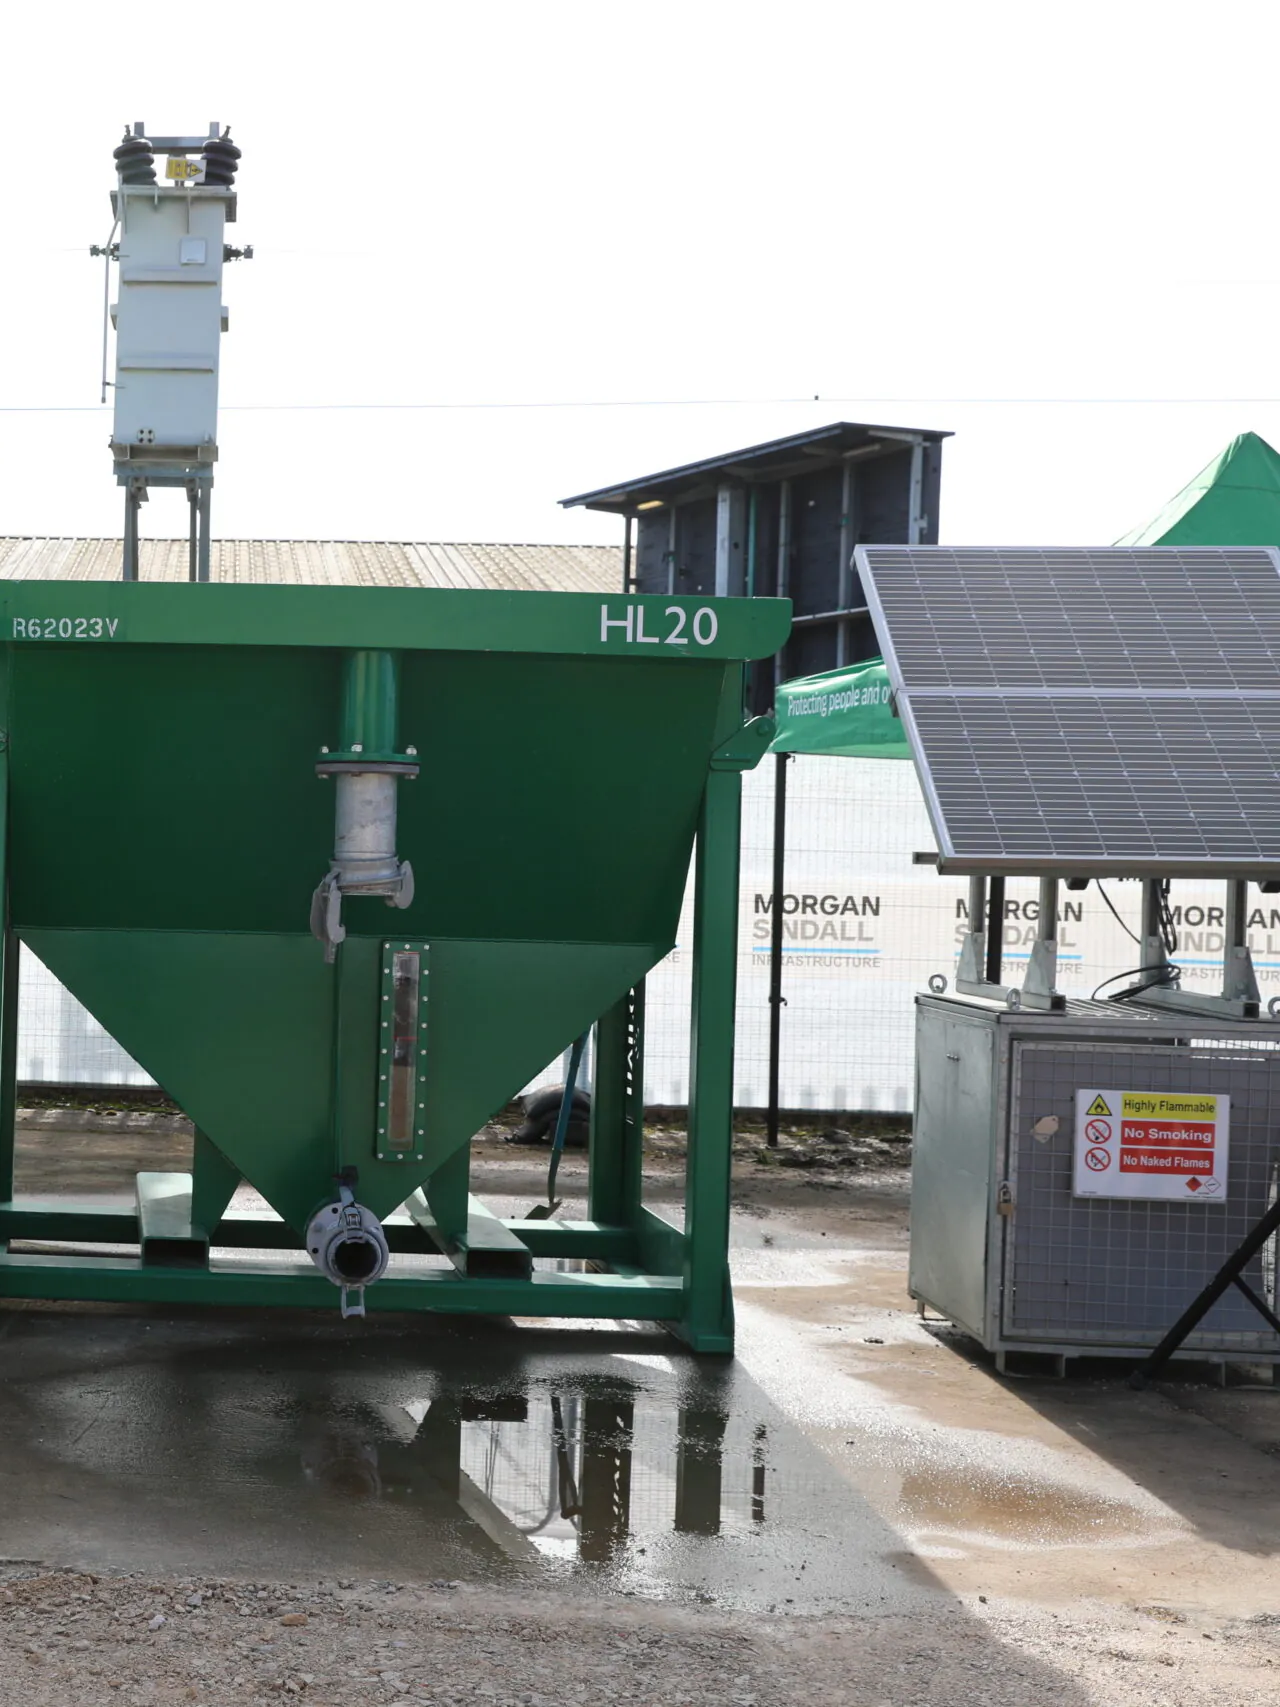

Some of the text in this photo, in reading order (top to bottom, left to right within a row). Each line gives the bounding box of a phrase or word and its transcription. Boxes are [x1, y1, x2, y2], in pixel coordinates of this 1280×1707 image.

[12, 618, 119, 639] R62023V
[599, 604, 719, 646] HL20
[787, 690, 827, 717] Protecting
[828, 684, 860, 714] people
[860, 680, 880, 706] and
[753, 893, 880, 917] MORGAN
[956, 898, 1083, 922] MRGN
[752, 918, 875, 942] SNDALL
[954, 923, 1077, 948] SDAL
[1123, 1099, 1216, 1114] Highly Flammable
[1124, 1127, 1212, 1144] No Smoking
[1123, 1154, 1210, 1169] No Naked Flames
